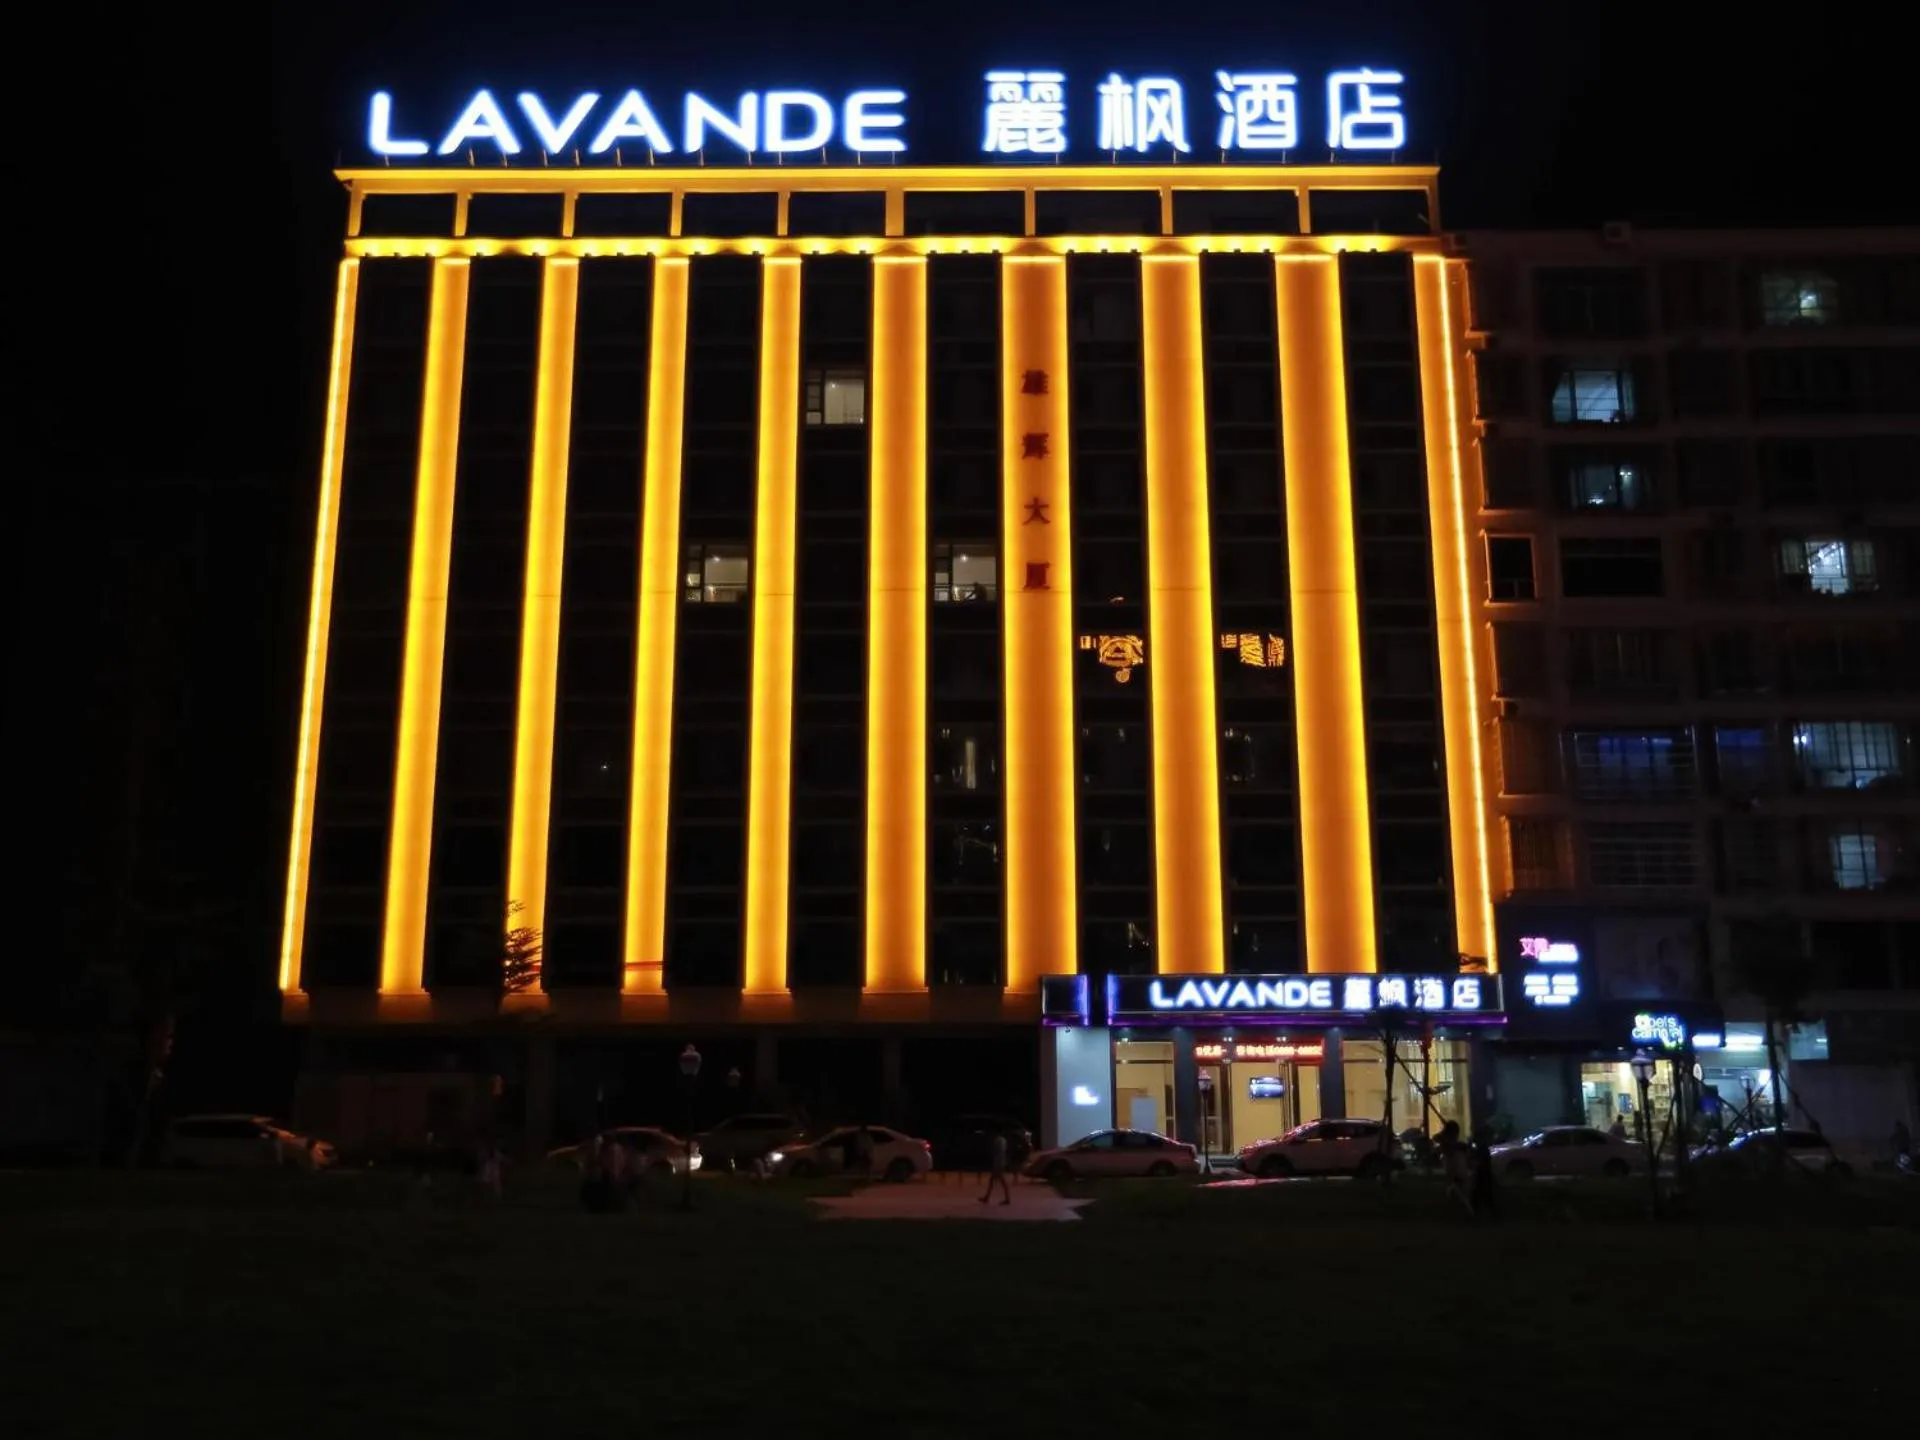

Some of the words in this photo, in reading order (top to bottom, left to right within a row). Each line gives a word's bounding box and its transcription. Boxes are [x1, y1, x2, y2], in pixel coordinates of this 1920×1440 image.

[369, 89, 906, 155] LAVANDE
[984, 69, 1406, 153] 麗枫酒店
[1151, 980, 1332, 1008] LAVANDE
